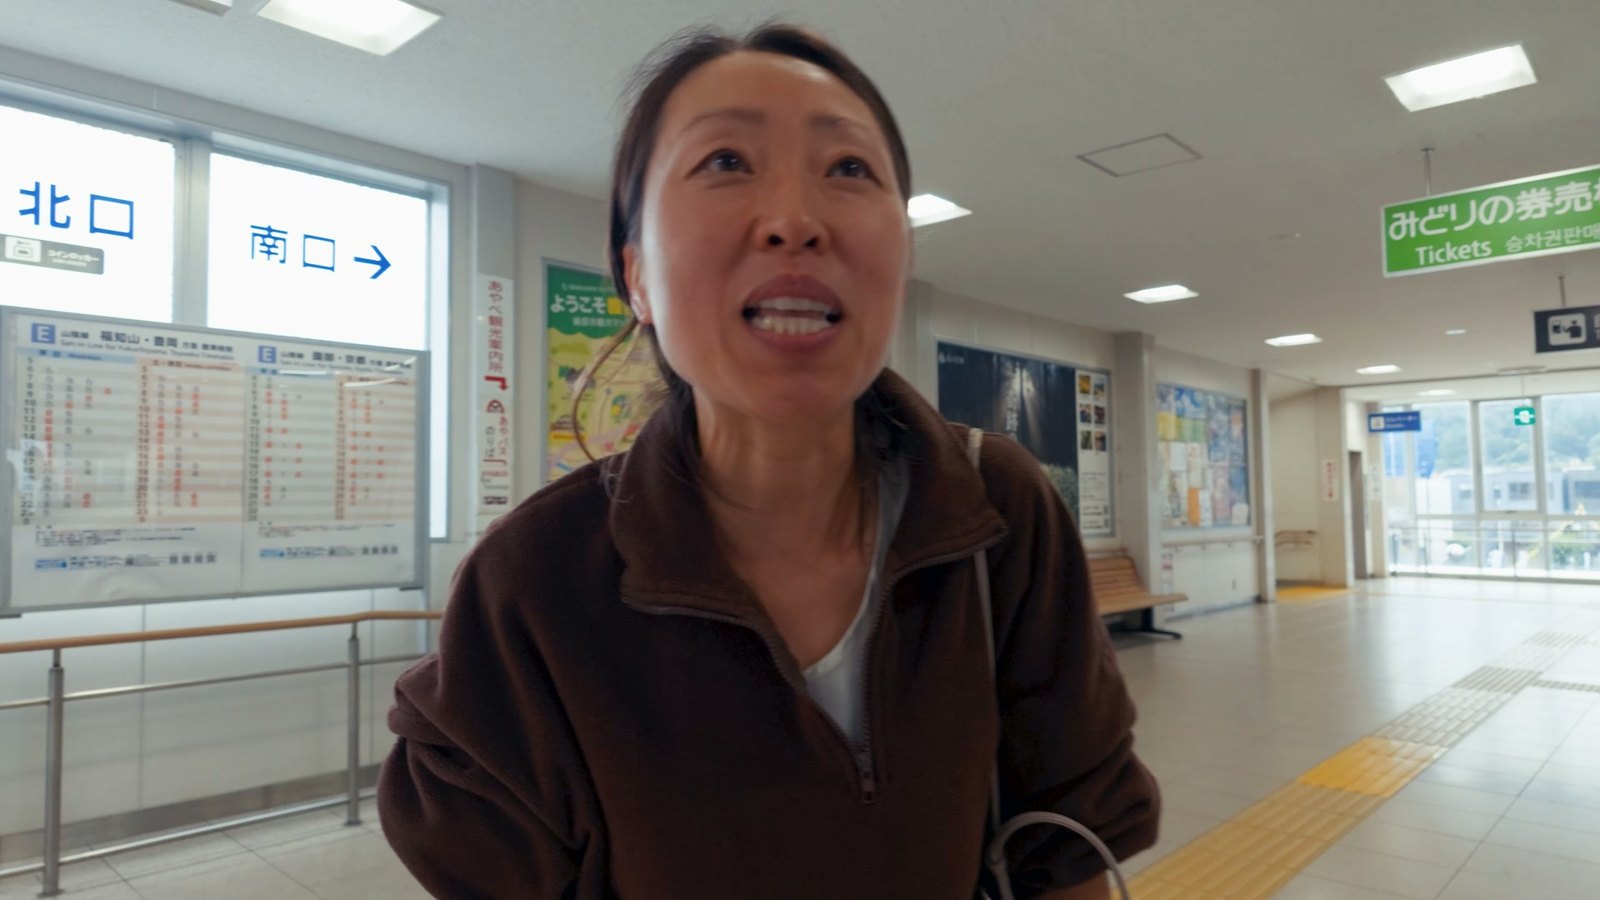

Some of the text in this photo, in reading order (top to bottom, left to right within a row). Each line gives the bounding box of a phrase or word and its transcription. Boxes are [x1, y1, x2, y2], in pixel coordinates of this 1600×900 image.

[19, 181, 134, 240] 北口
[1389, 176, 1600, 240] みどりの券売
[250, 225, 335, 272] 南口
[1416, 240, 1493, 266] Tickets
[37, 326, 50, 341] E
[263, 347, 273, 361] E
